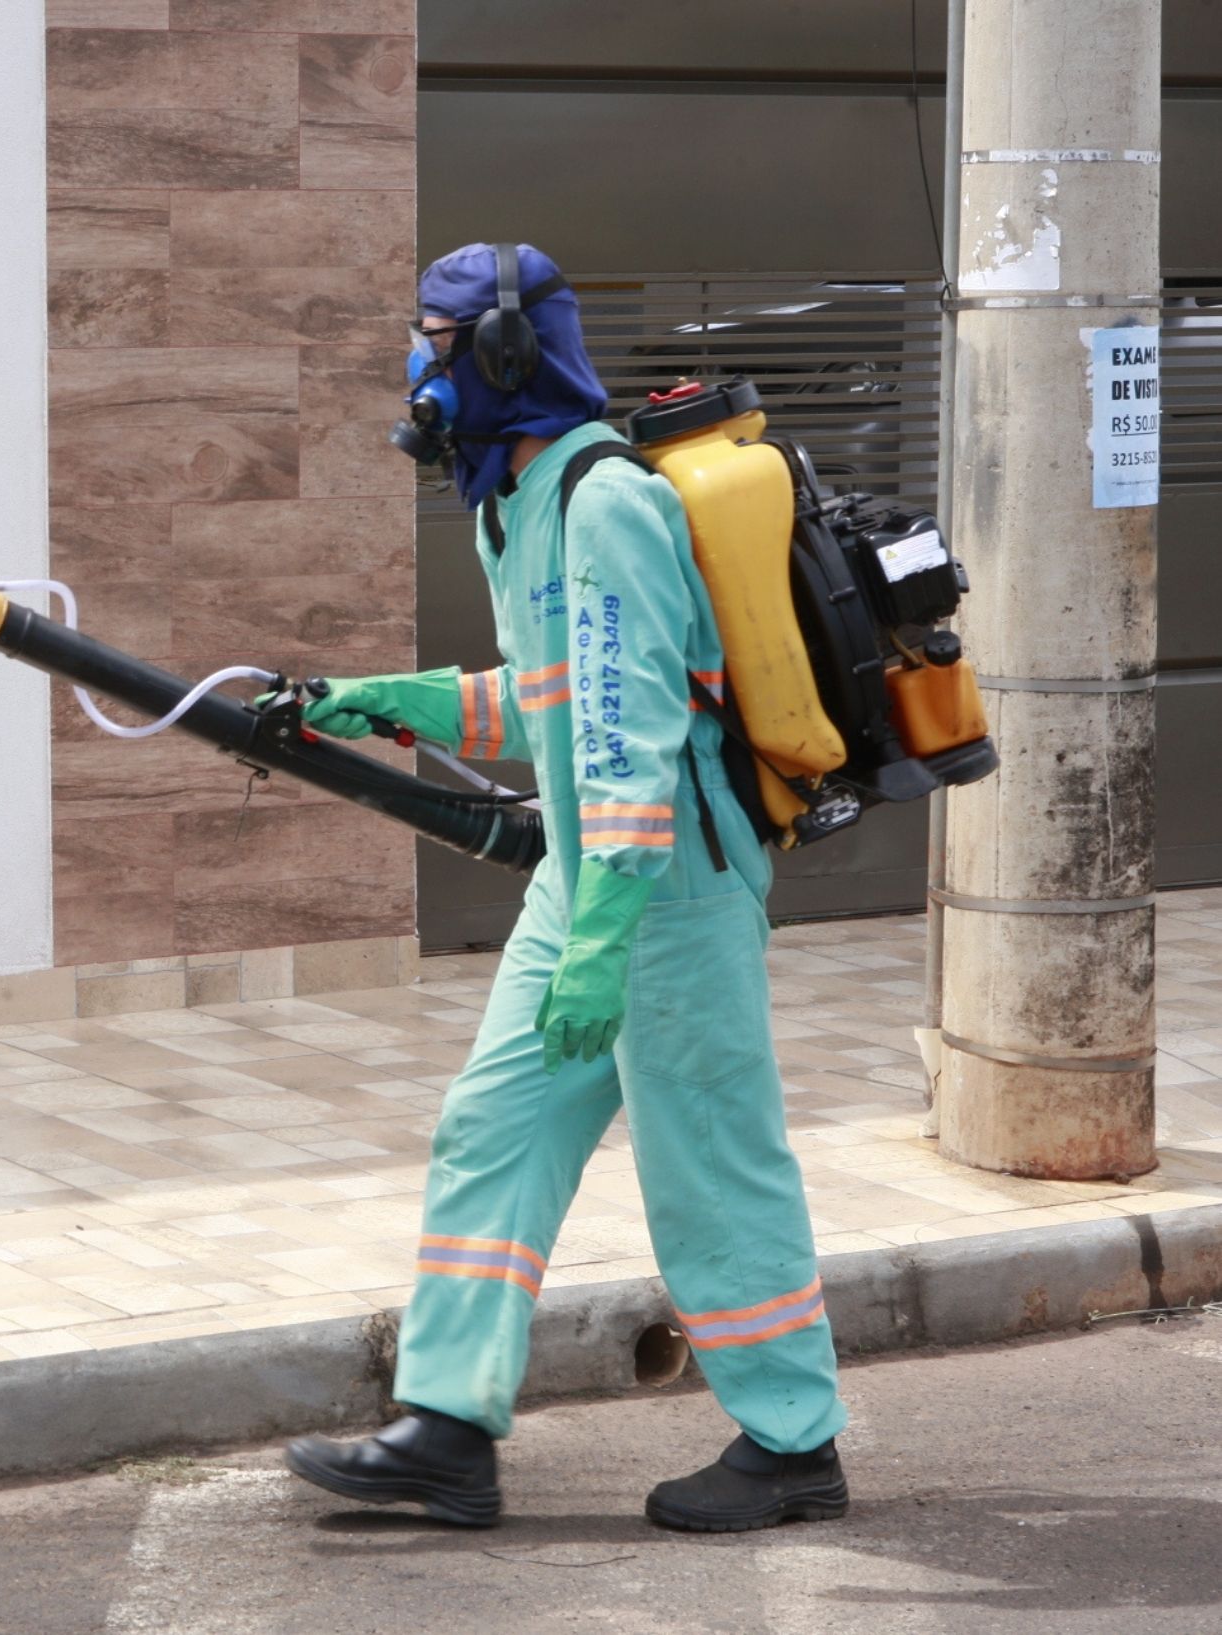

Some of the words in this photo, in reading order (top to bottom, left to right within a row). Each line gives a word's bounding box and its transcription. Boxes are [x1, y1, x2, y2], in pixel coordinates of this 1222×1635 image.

[1111, 346, 1157, 367] EXAME
[1111, 380, 1131, 401] DE
[1111, 414, 1131, 436] R$
[602, 594, 621, 725] 3217-3409
[606, 731, 635, 778] (34)
